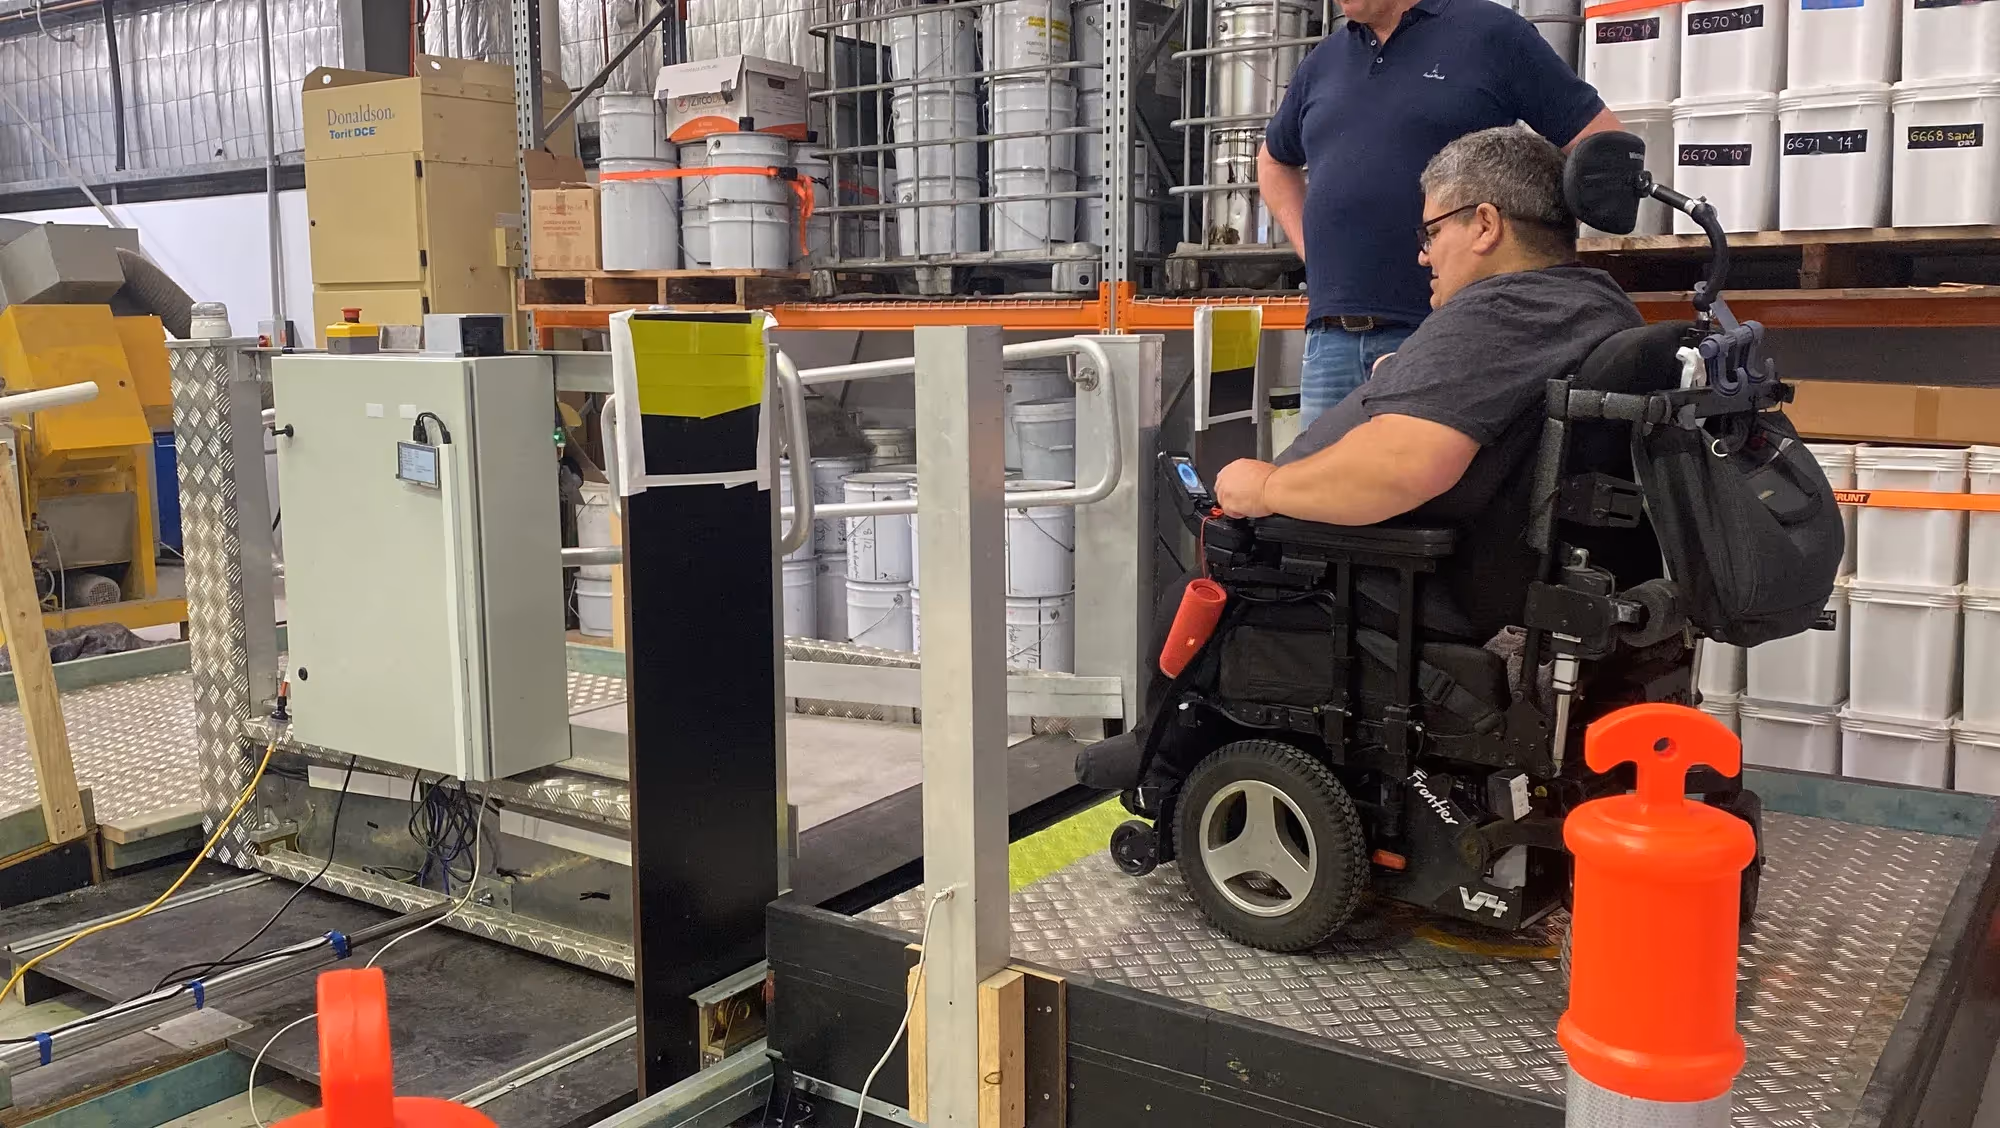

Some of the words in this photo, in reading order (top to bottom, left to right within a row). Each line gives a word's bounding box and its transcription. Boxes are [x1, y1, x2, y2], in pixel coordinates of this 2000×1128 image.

[1692, 16, 1730, 31] 6670
[1598, 25, 1633, 38] 6670
[354, 126, 376, 137] DCE
[1910, 130, 1944, 142] 6668
[1786, 137, 1821, 151] 6671
[1681, 149, 1718, 161] 6670
[1406, 765, 1459, 825] Frontier
[1459, 886, 1509, 918] V4
